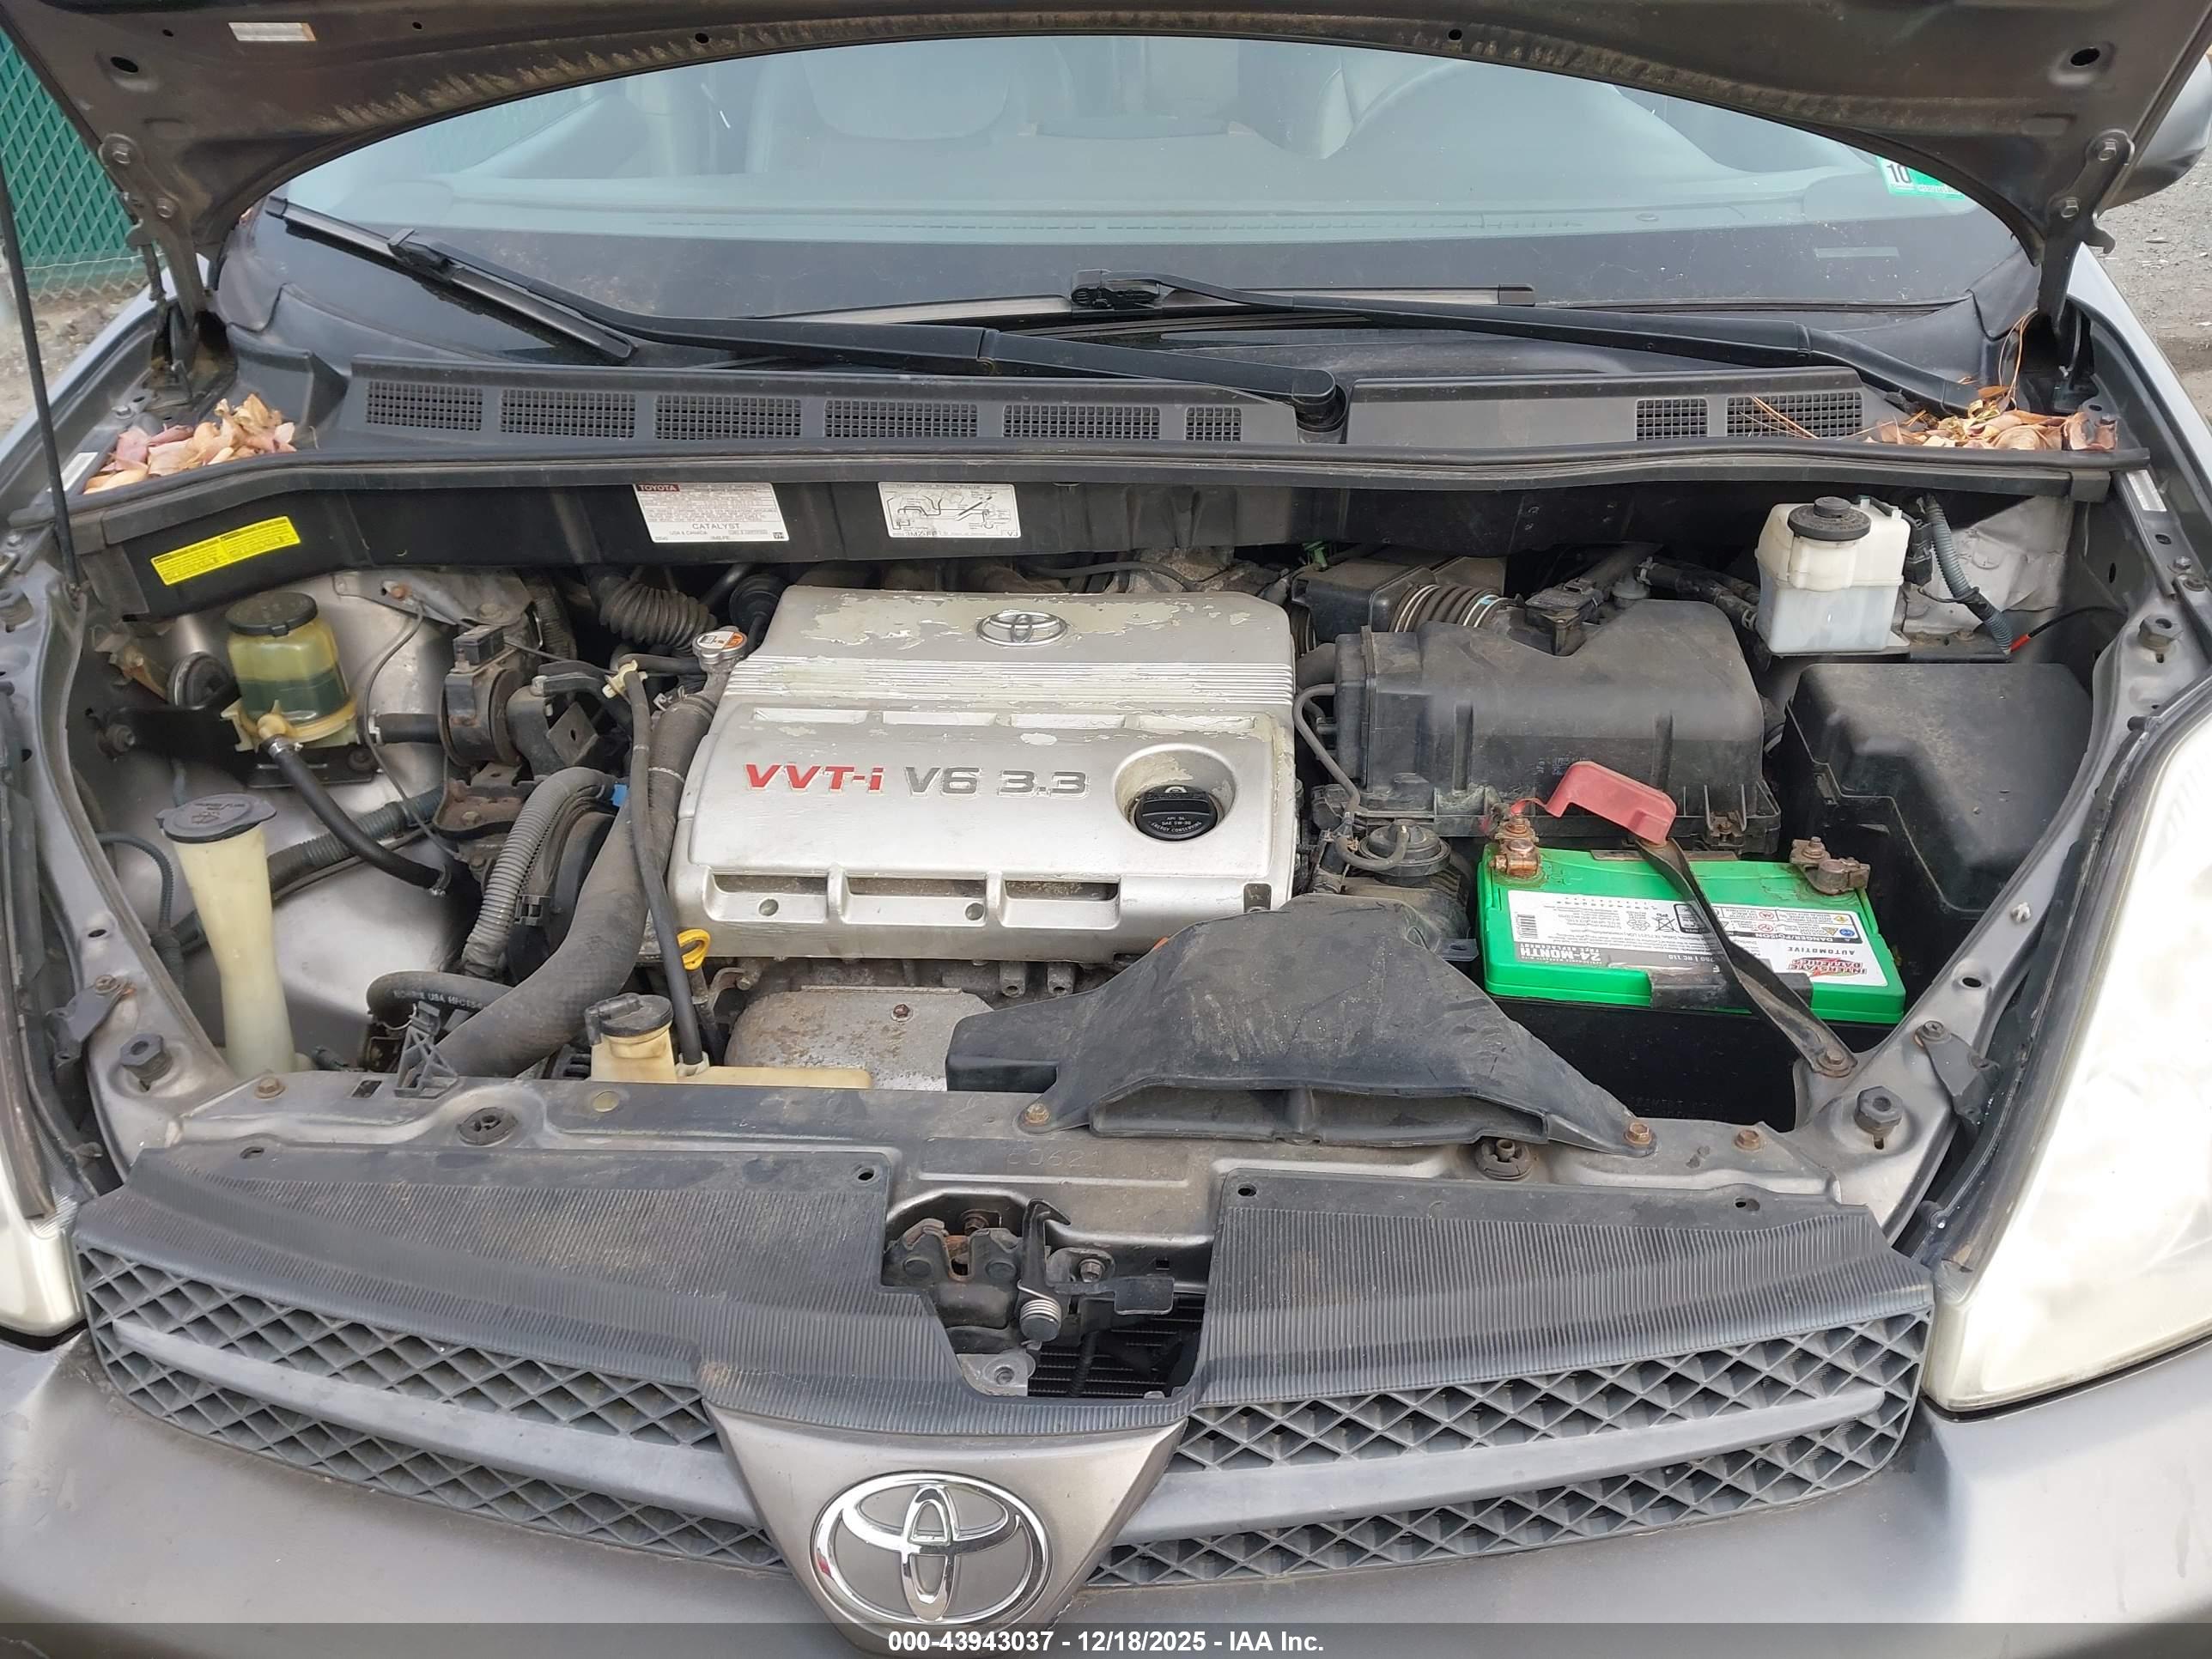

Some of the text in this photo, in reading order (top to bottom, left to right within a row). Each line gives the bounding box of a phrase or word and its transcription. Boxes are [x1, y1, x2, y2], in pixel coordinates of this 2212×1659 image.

[1887, 163, 1912, 184] 10
[744, 763, 1089, 799] VVT-i V6 3.3
[1151, 822, 1202, 832] ENERGY CONSERVING
[1754, 933, 1833, 943] DANGER/POISON
[1519, 947, 1601, 962] 24-MONTH
[1787, 946, 1856, 956] AUTOMOTIVE
[1788, 957, 1863, 968] BATTERIES
[1786, 963, 1868, 975] INTERSTATE
